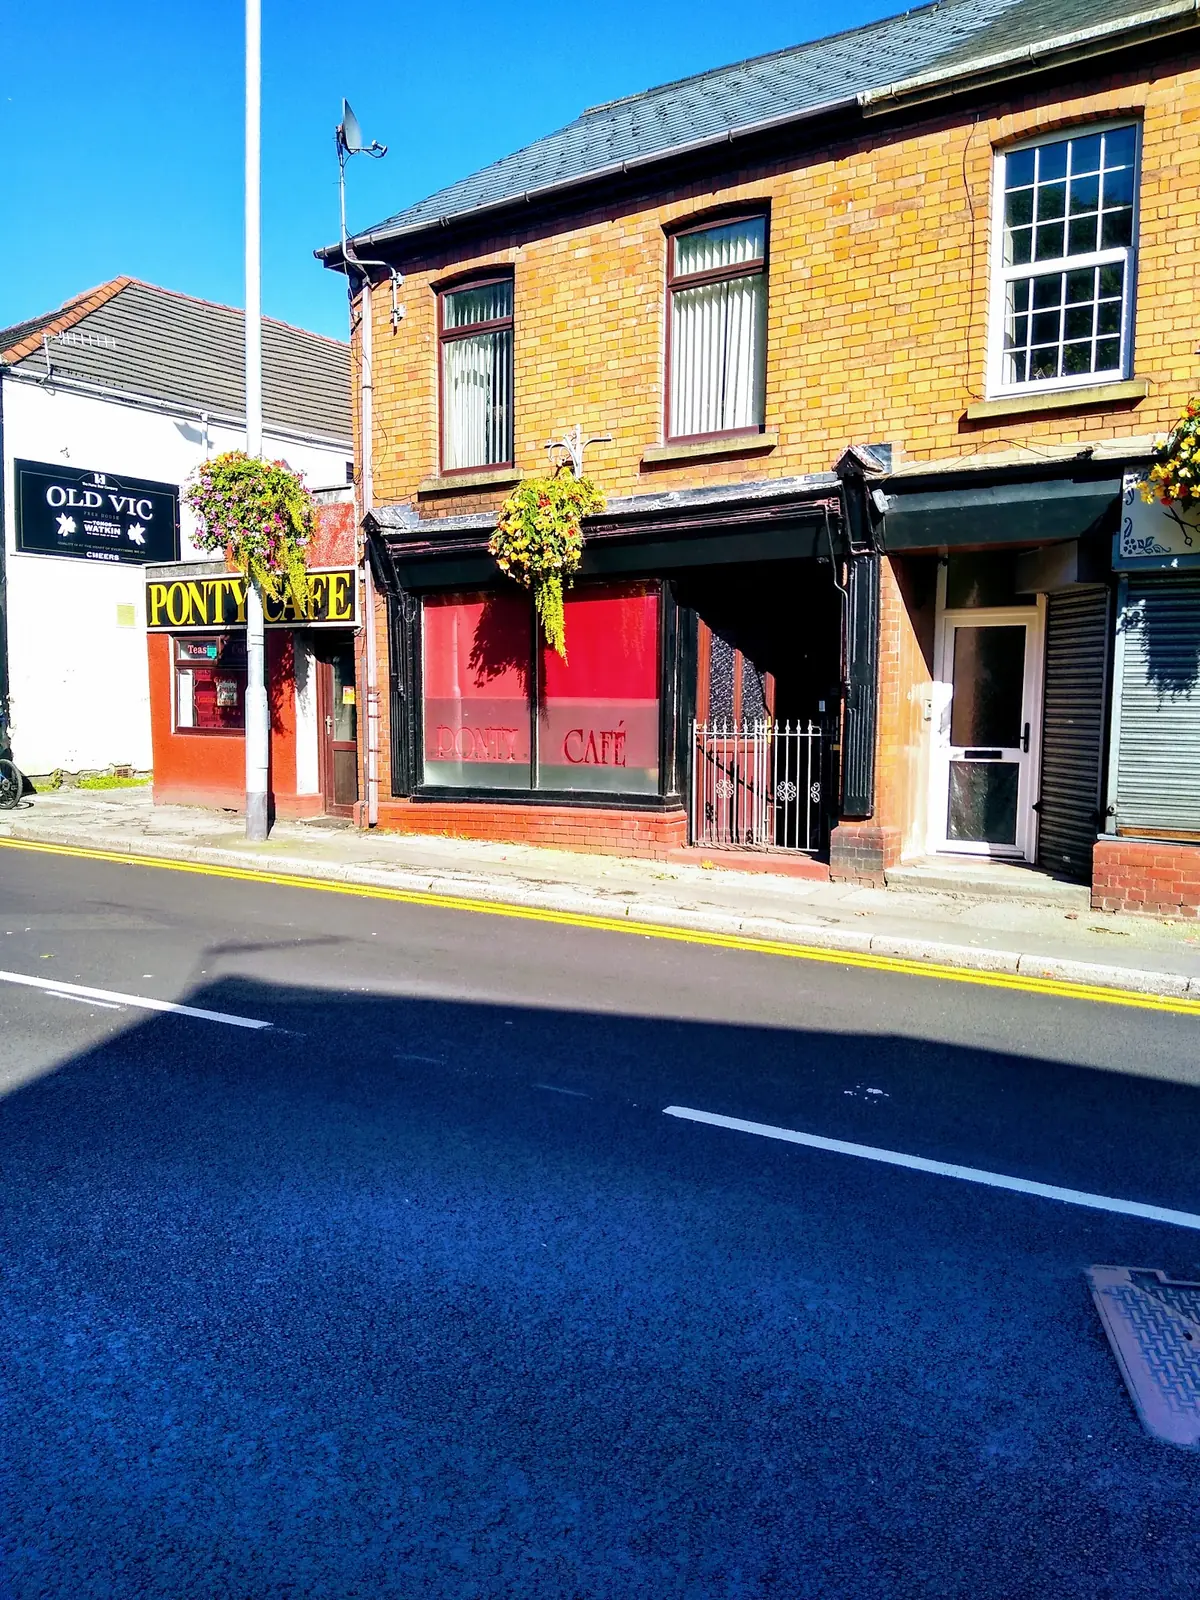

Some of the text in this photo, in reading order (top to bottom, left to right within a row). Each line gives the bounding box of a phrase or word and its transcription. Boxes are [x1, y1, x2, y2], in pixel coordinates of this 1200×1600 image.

[46, 485, 153, 521] OLD VIC
[84, 524, 121, 535] WATKIN
[86, 551, 120, 560] CHEERS
[148, 579, 247, 626] PONTY
[187, 644, 207, 654] Teas
[436, 720, 626, 767] PONTY CAFÉ
